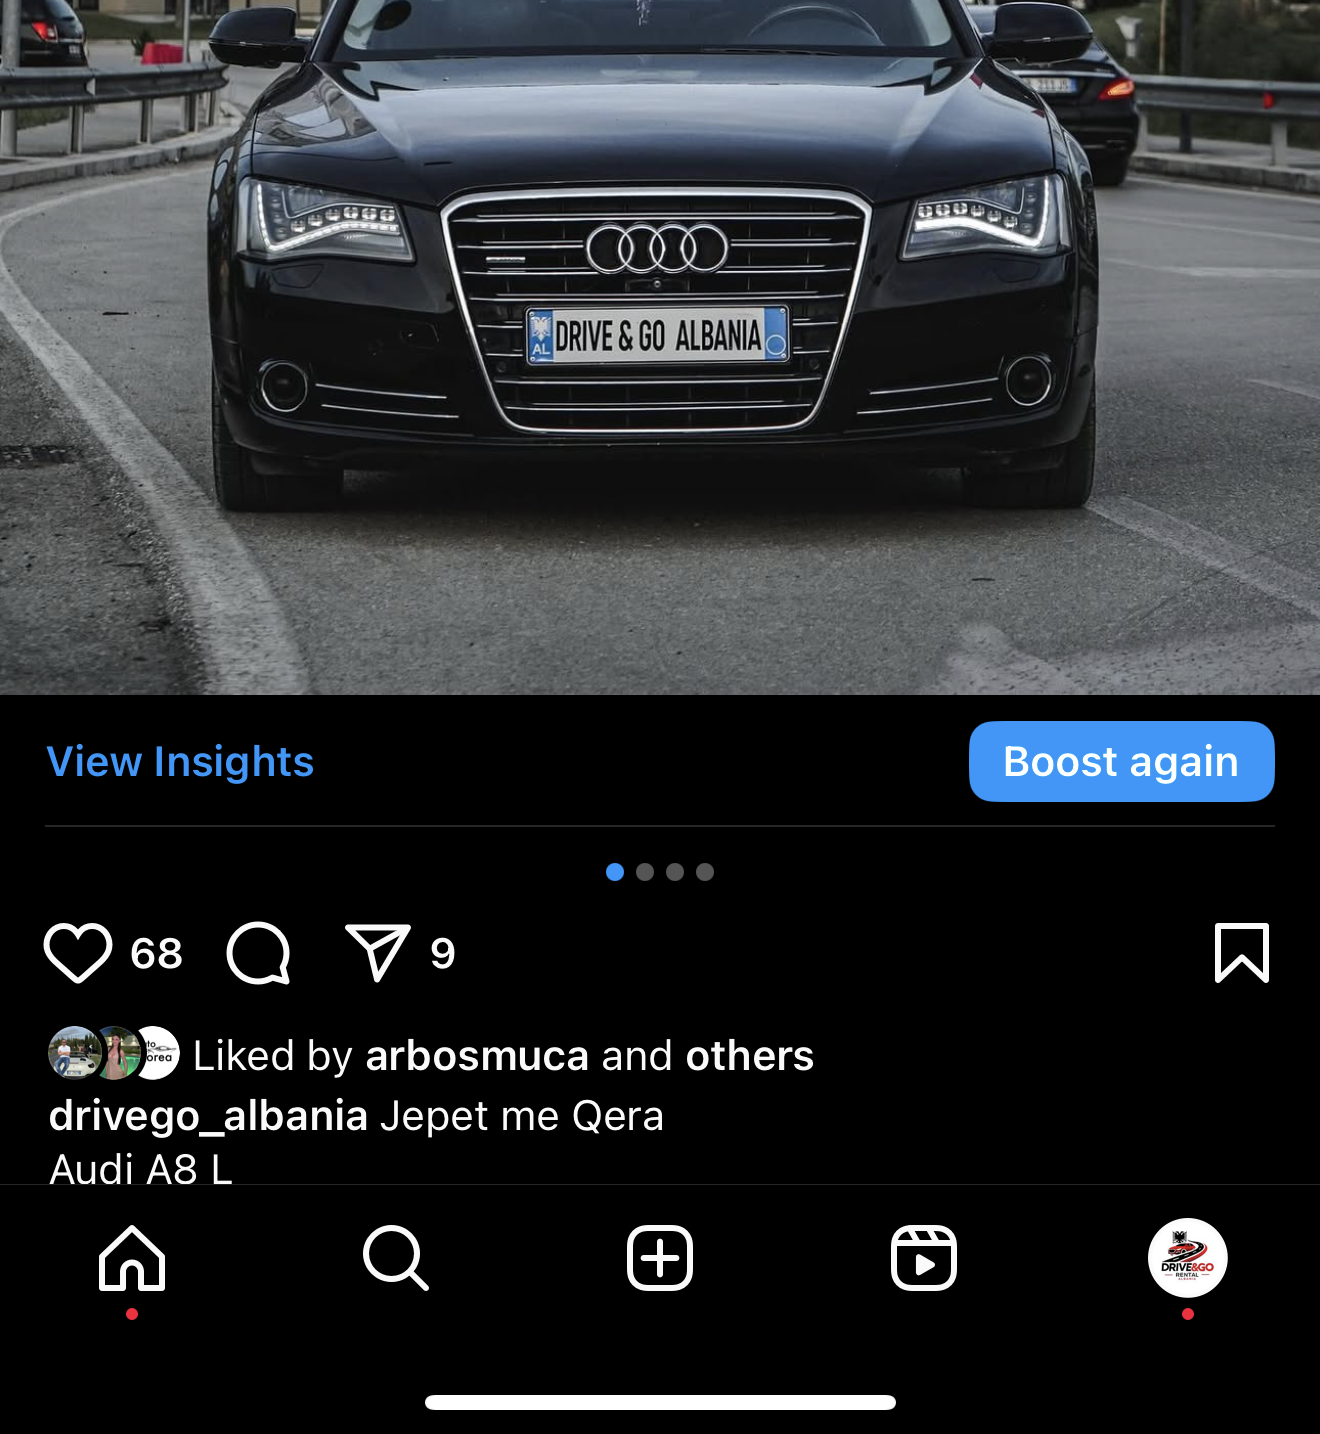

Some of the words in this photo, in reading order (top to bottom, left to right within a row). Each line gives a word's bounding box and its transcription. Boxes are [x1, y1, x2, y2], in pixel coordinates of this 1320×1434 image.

[556, 320, 613, 352] DRIVE
[618, 320, 634, 352] &
[639, 319, 665, 352] GO
[675, 319, 762, 351] ALBANIA
[532, 343, 551, 355] AL
